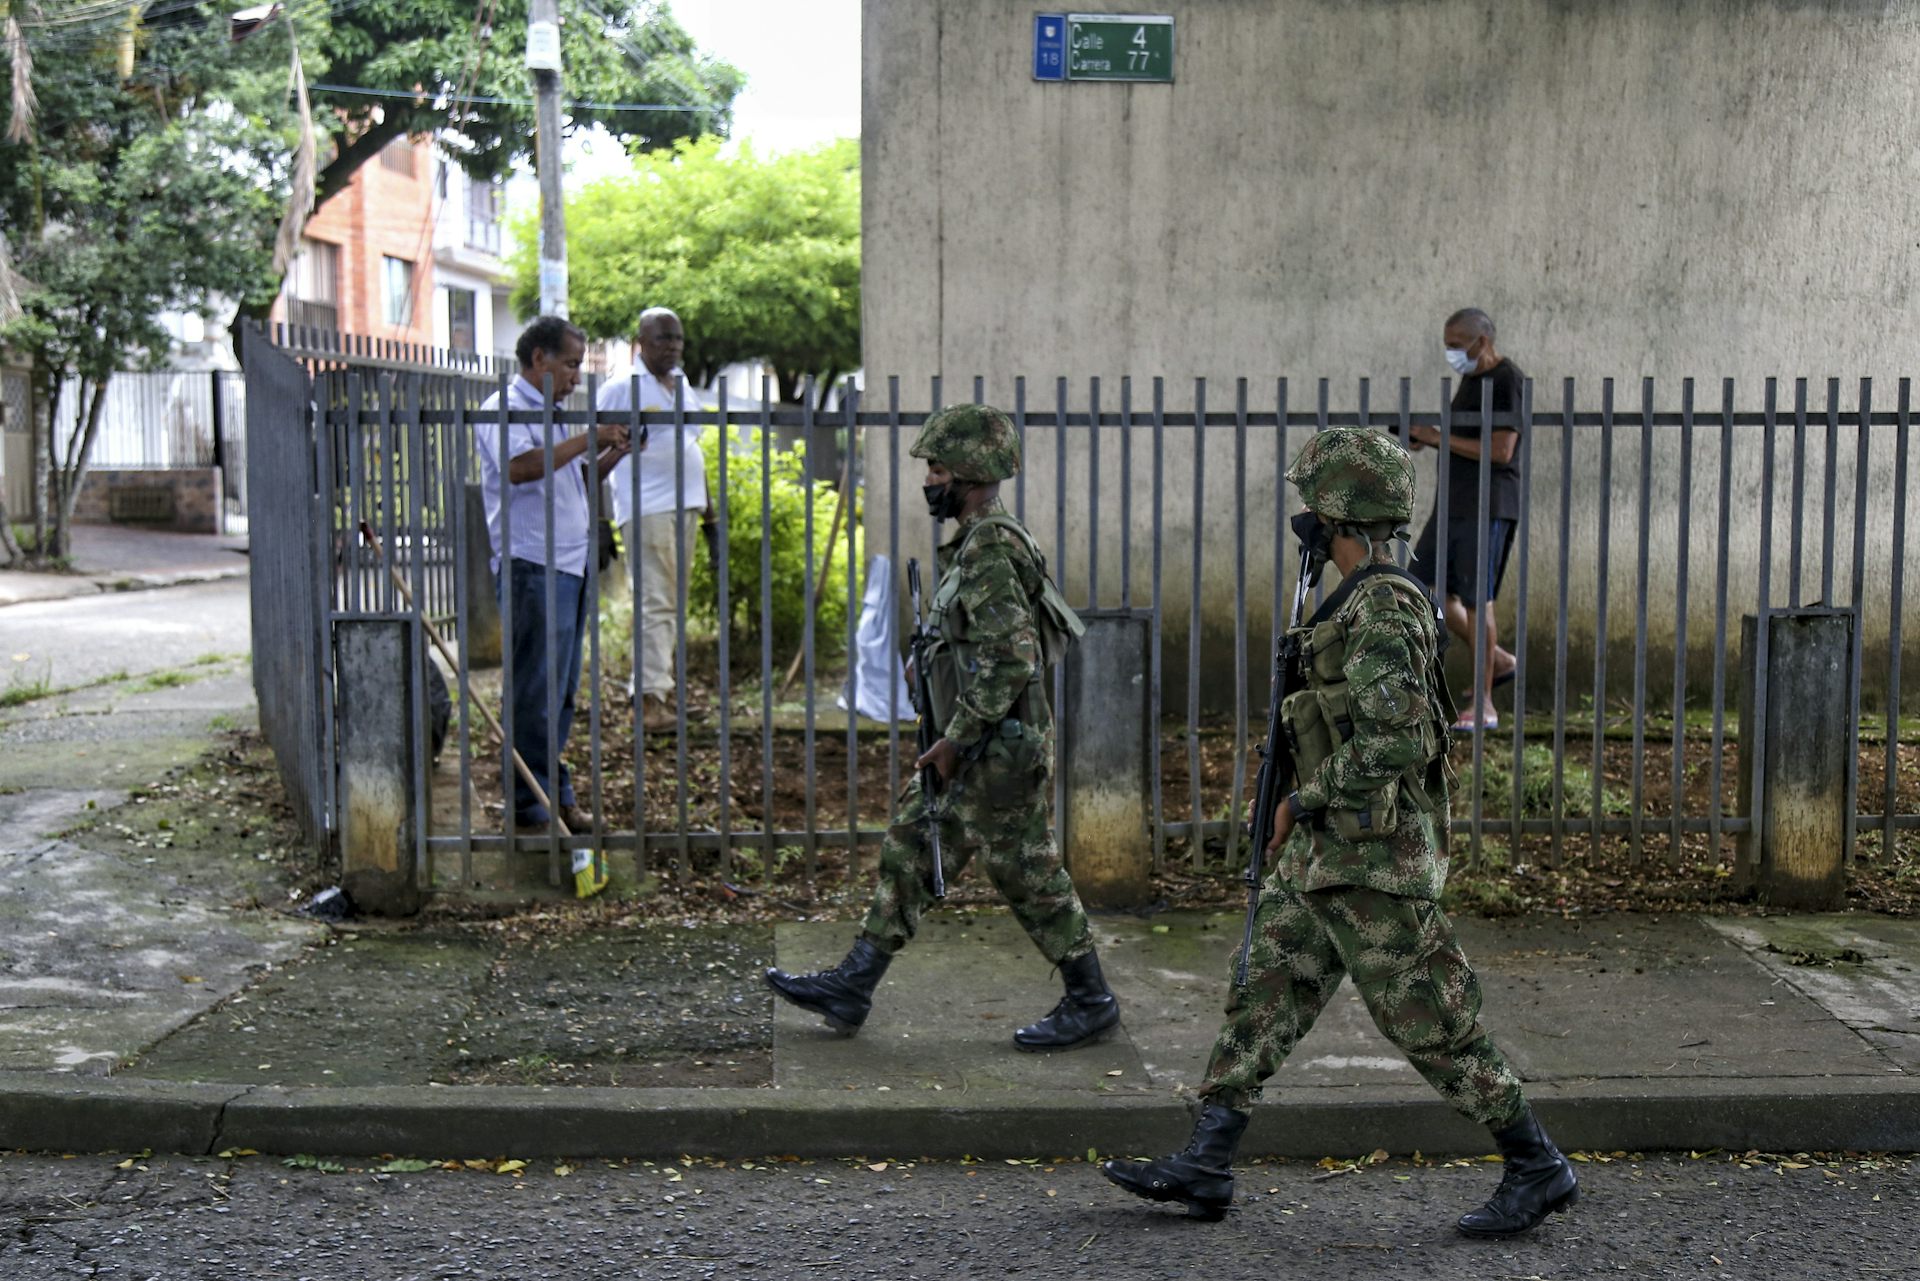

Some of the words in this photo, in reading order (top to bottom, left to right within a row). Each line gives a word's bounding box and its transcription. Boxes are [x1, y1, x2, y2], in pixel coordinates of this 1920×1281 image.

[1071, 24, 1104, 49] Calle
[1132, 26, 1147, 49] 4
[1042, 52, 1059, 66] 18
[1071, 50, 1111, 71] Carrera
[1127, 51, 1150, 70] 77
